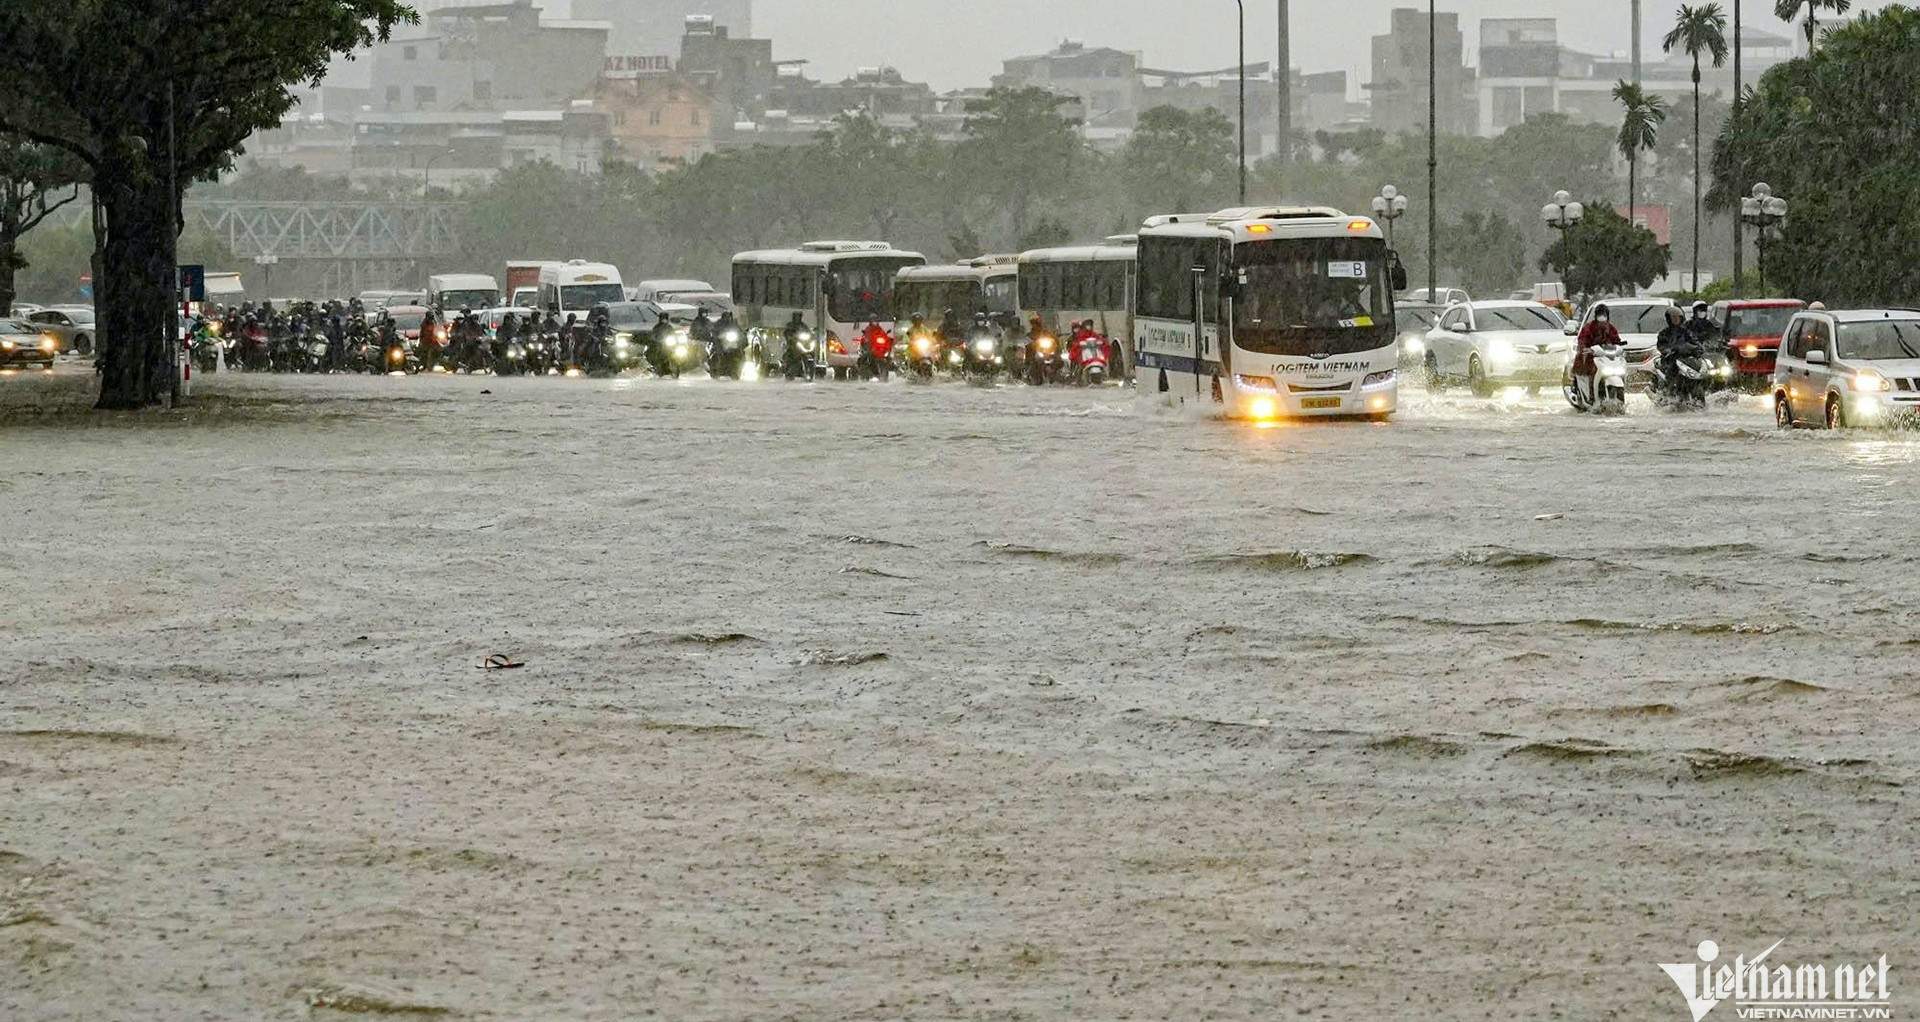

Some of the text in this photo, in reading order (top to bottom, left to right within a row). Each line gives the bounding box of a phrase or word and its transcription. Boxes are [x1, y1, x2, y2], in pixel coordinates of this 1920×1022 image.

[604, 56, 673, 71] AZ HOTEL
[1353, 262, 1363, 276] B
[1271, 361, 1370, 374] LOGITEM VIETNAM
